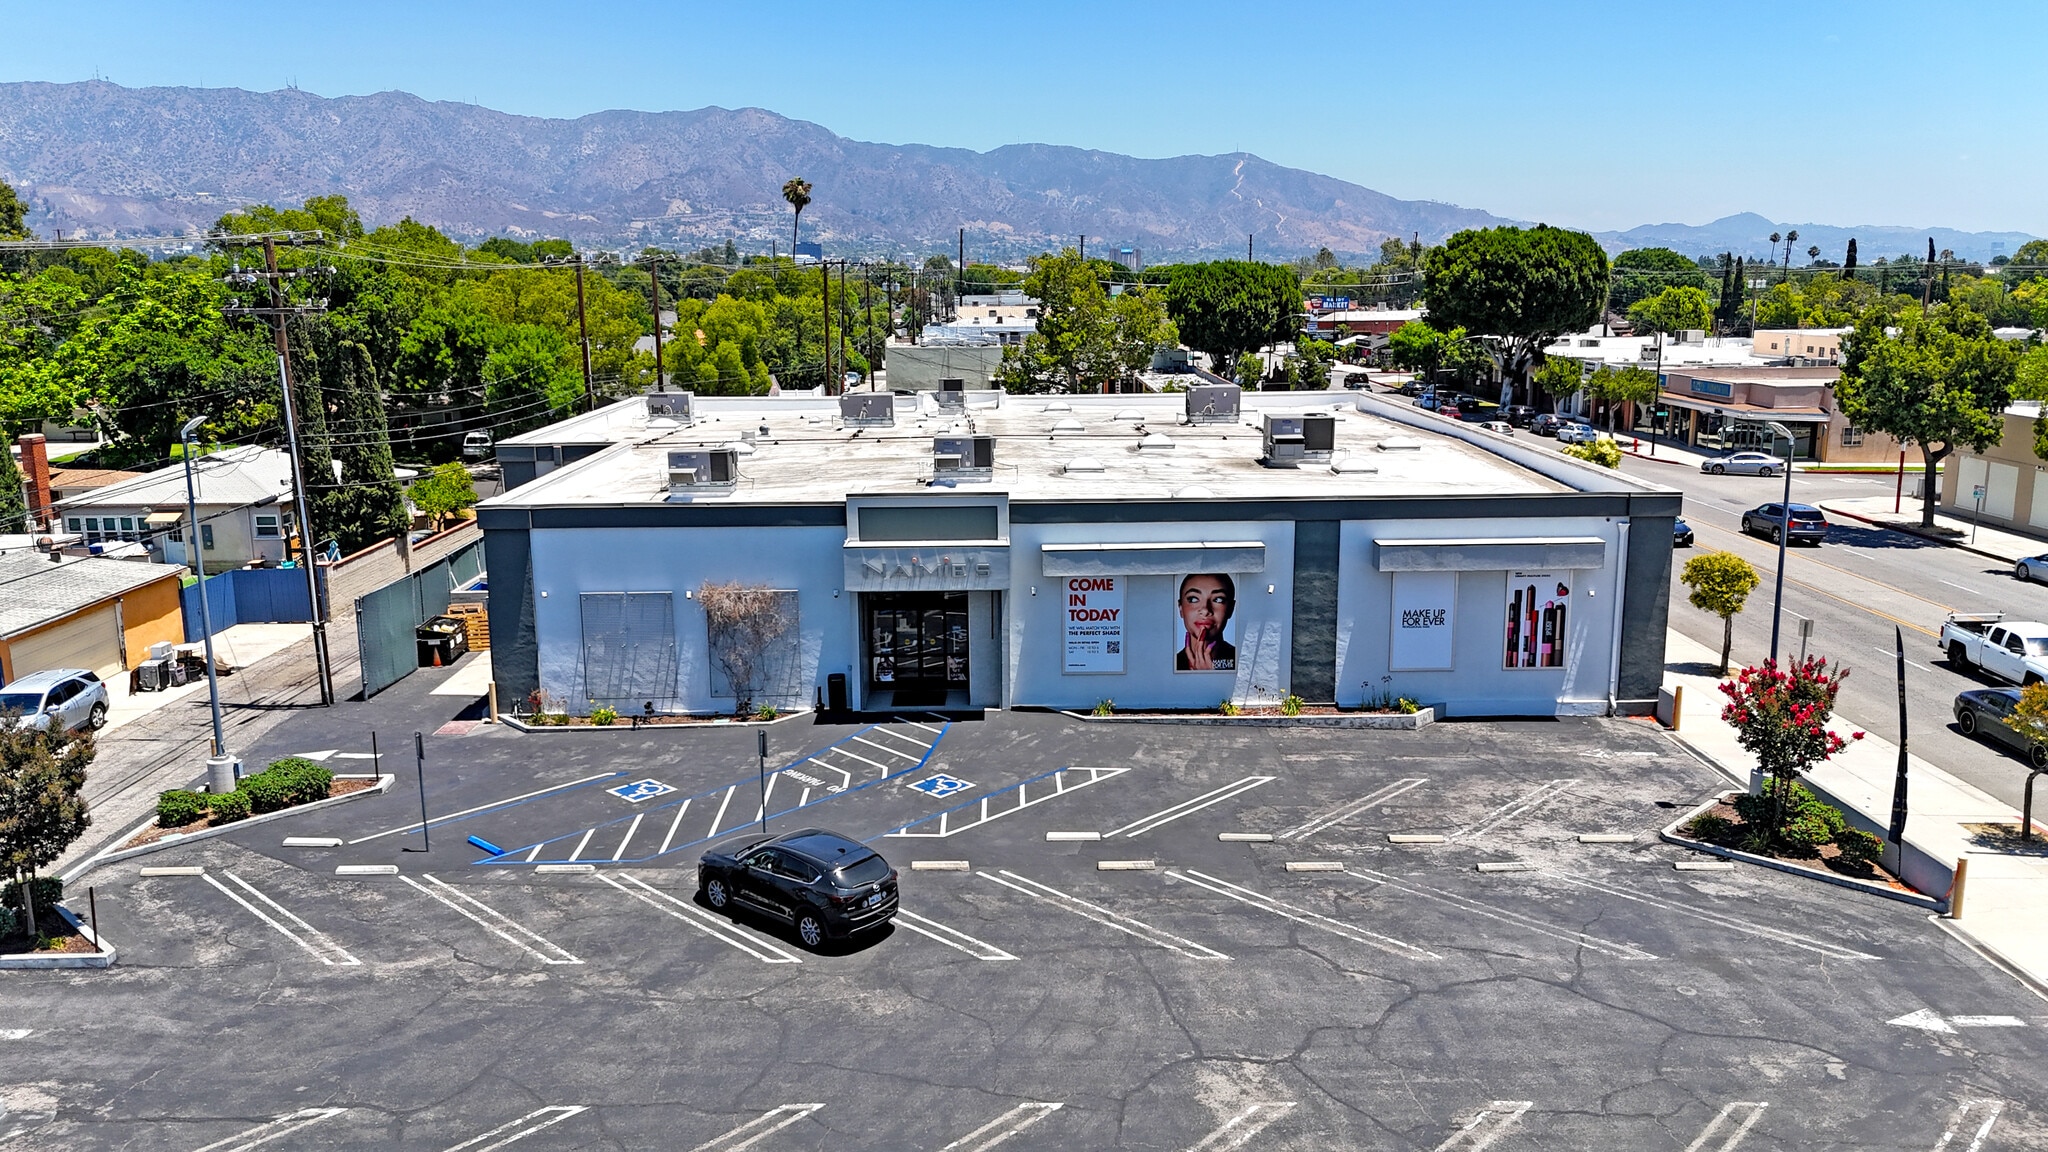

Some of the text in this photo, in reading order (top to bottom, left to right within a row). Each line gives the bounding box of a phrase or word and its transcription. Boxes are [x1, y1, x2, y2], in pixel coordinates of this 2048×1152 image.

[1069, 578, 1113, 592] COME
[1069, 594, 1086, 606] IN
[1068, 609, 1120, 622] TODAY
[1402, 609, 1446, 618] MAKE UP
[1402, 617, 1445, 626] FOR EVER
[782, 769, 826, 786] PARKING
